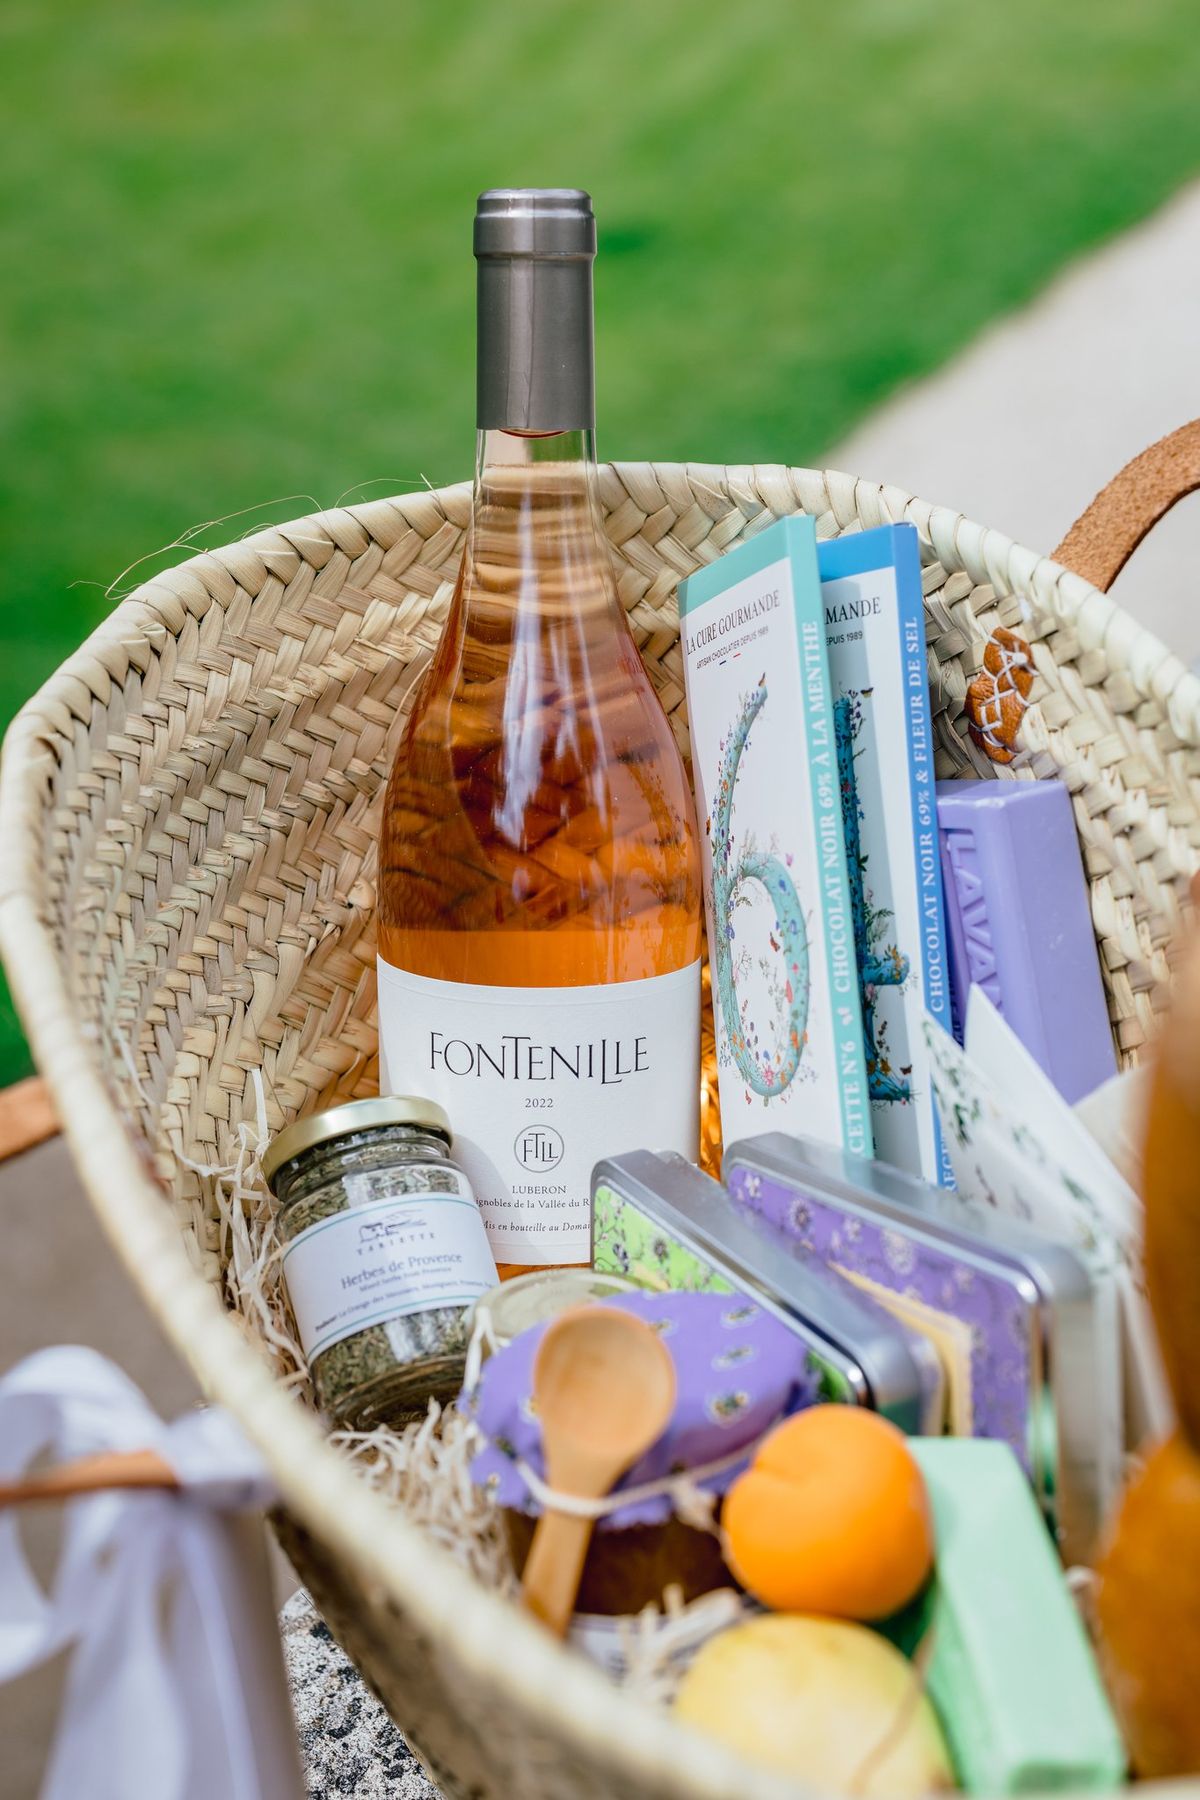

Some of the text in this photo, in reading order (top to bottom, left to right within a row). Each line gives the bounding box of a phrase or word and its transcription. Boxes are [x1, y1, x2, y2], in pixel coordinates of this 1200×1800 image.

[686, 590, 780, 656] LA CURE GOURMANDE
[824, 597, 881, 625] MANDE
[696, 655, 712, 670] ARTISAN
[712, 639, 740, 661] CHOCOLATIER
[740, 631, 757, 646] DEPUIS
[825, 631, 863, 647] EPUIS 1989
[802, 620, 825, 713] MENTHE
[812, 718, 829, 748] LA
[811, 752, 831, 767] À
[816, 771, 834, 809] 69%
[905, 616, 945, 1013] CHOCOLAT NOIR 69% & FLEUR DE SEL
[819, 814, 840, 868] NOIR
[824, 874, 851, 994] CHOCOLAT
[429, 1031, 650, 1085] FONTENILLE
[524, 1098, 554, 1109] 2022
[843, 1080, 865, 1154] CETTE
[476, 1197, 512, 1208] ignobles
[514, 1199, 525, 1209] de
[527, 1199, 535, 1209] la
[538, 1199, 566, 1209] Vallée
[568, 1199, 580, 1208] du
[512, 1185, 567, 1195] LUBERON
[498, 1223, 508, 1231] en
[510, 1222, 546, 1232] bouteille
[549, 1224, 559, 1232] au
[341, 1266, 386, 1290] Herbes
[388, 1260, 405, 1273] de
[407, 1253, 463, 1268] Provence
